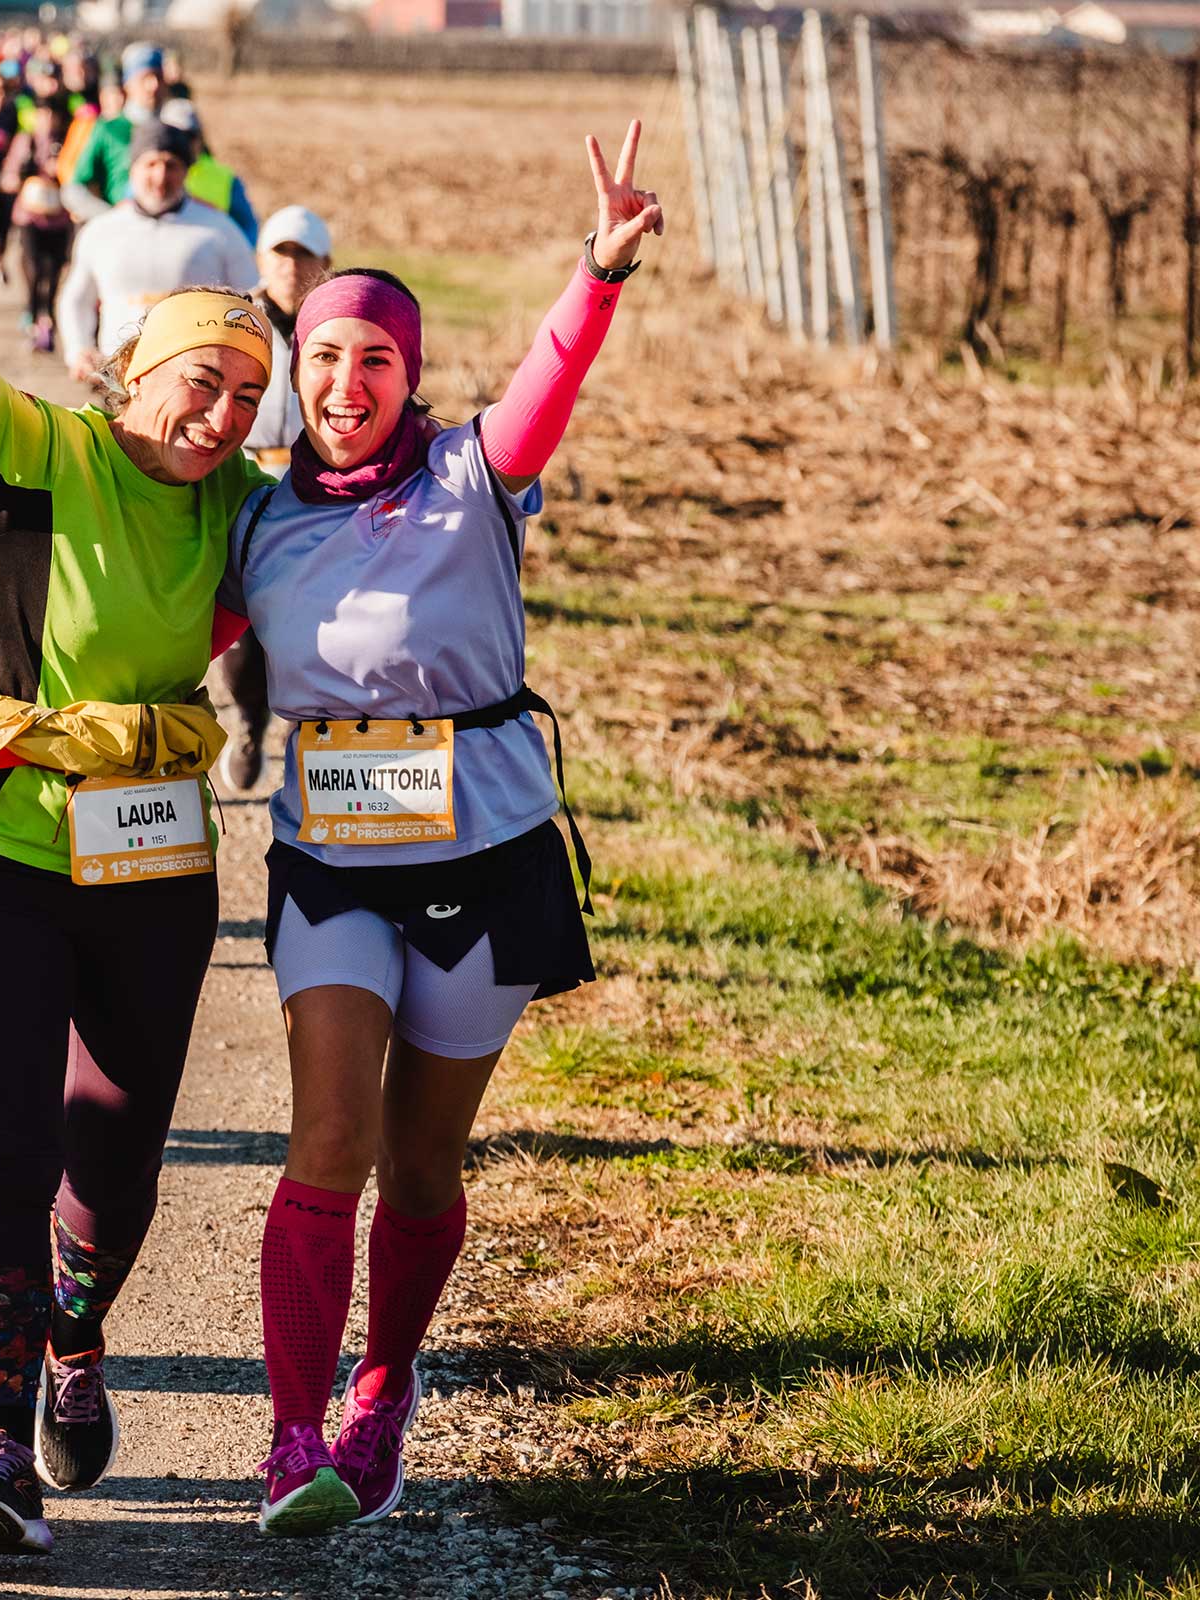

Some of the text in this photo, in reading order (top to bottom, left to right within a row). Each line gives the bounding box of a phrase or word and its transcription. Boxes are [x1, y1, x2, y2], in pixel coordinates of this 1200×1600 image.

[308, 768, 442, 791] MARIA VITTORIA
[117, 800, 177, 828] LAURA
[367, 802, 389, 811] 1632
[151, 835, 168, 845] 1151
[357, 825, 451, 840] PROSECCO RUN
[139, 856, 210, 874] PROSECCO RUN
